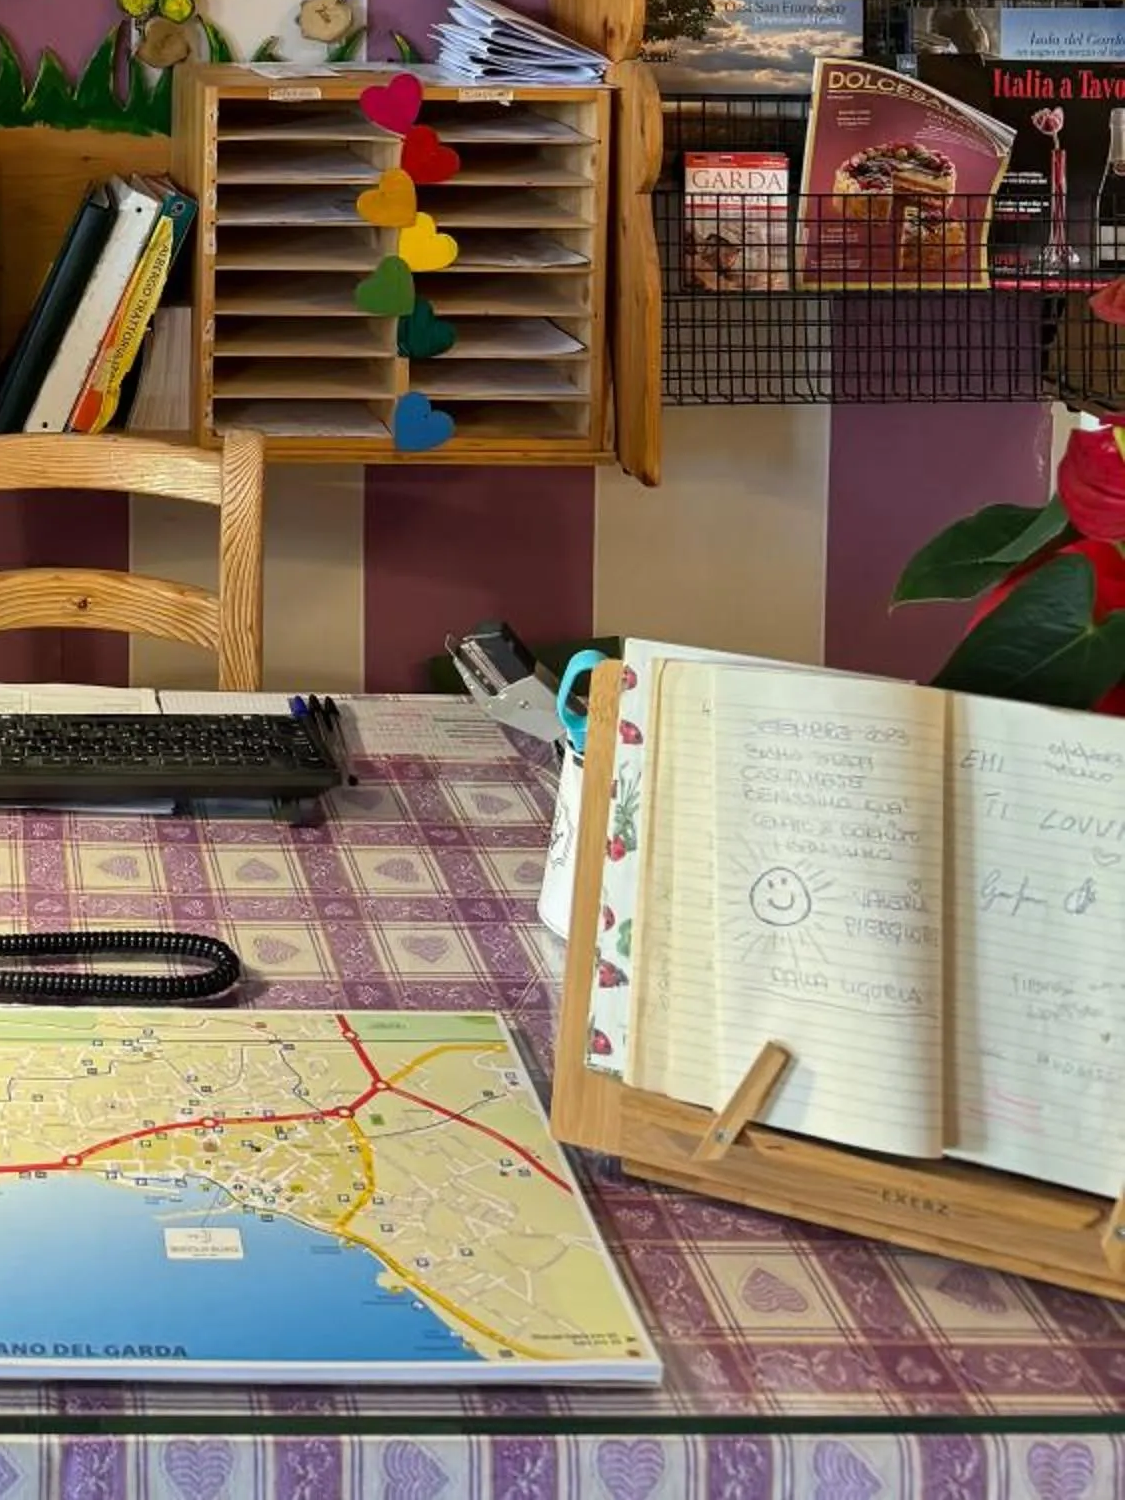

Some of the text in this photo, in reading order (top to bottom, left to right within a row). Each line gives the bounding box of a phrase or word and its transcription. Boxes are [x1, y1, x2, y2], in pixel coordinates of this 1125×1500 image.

[754, 1, 779, 14] San
[782, 1, 846, 15] Francesco
[1063, 31, 1084, 46] del
[992, 67, 1054, 99] Italia
[1060, 77, 1073, 99] a
[691, 169, 785, 190] GARDA
[52, 1342, 93, 1357] DEL
[103, 1343, 188, 1358] GARDA
